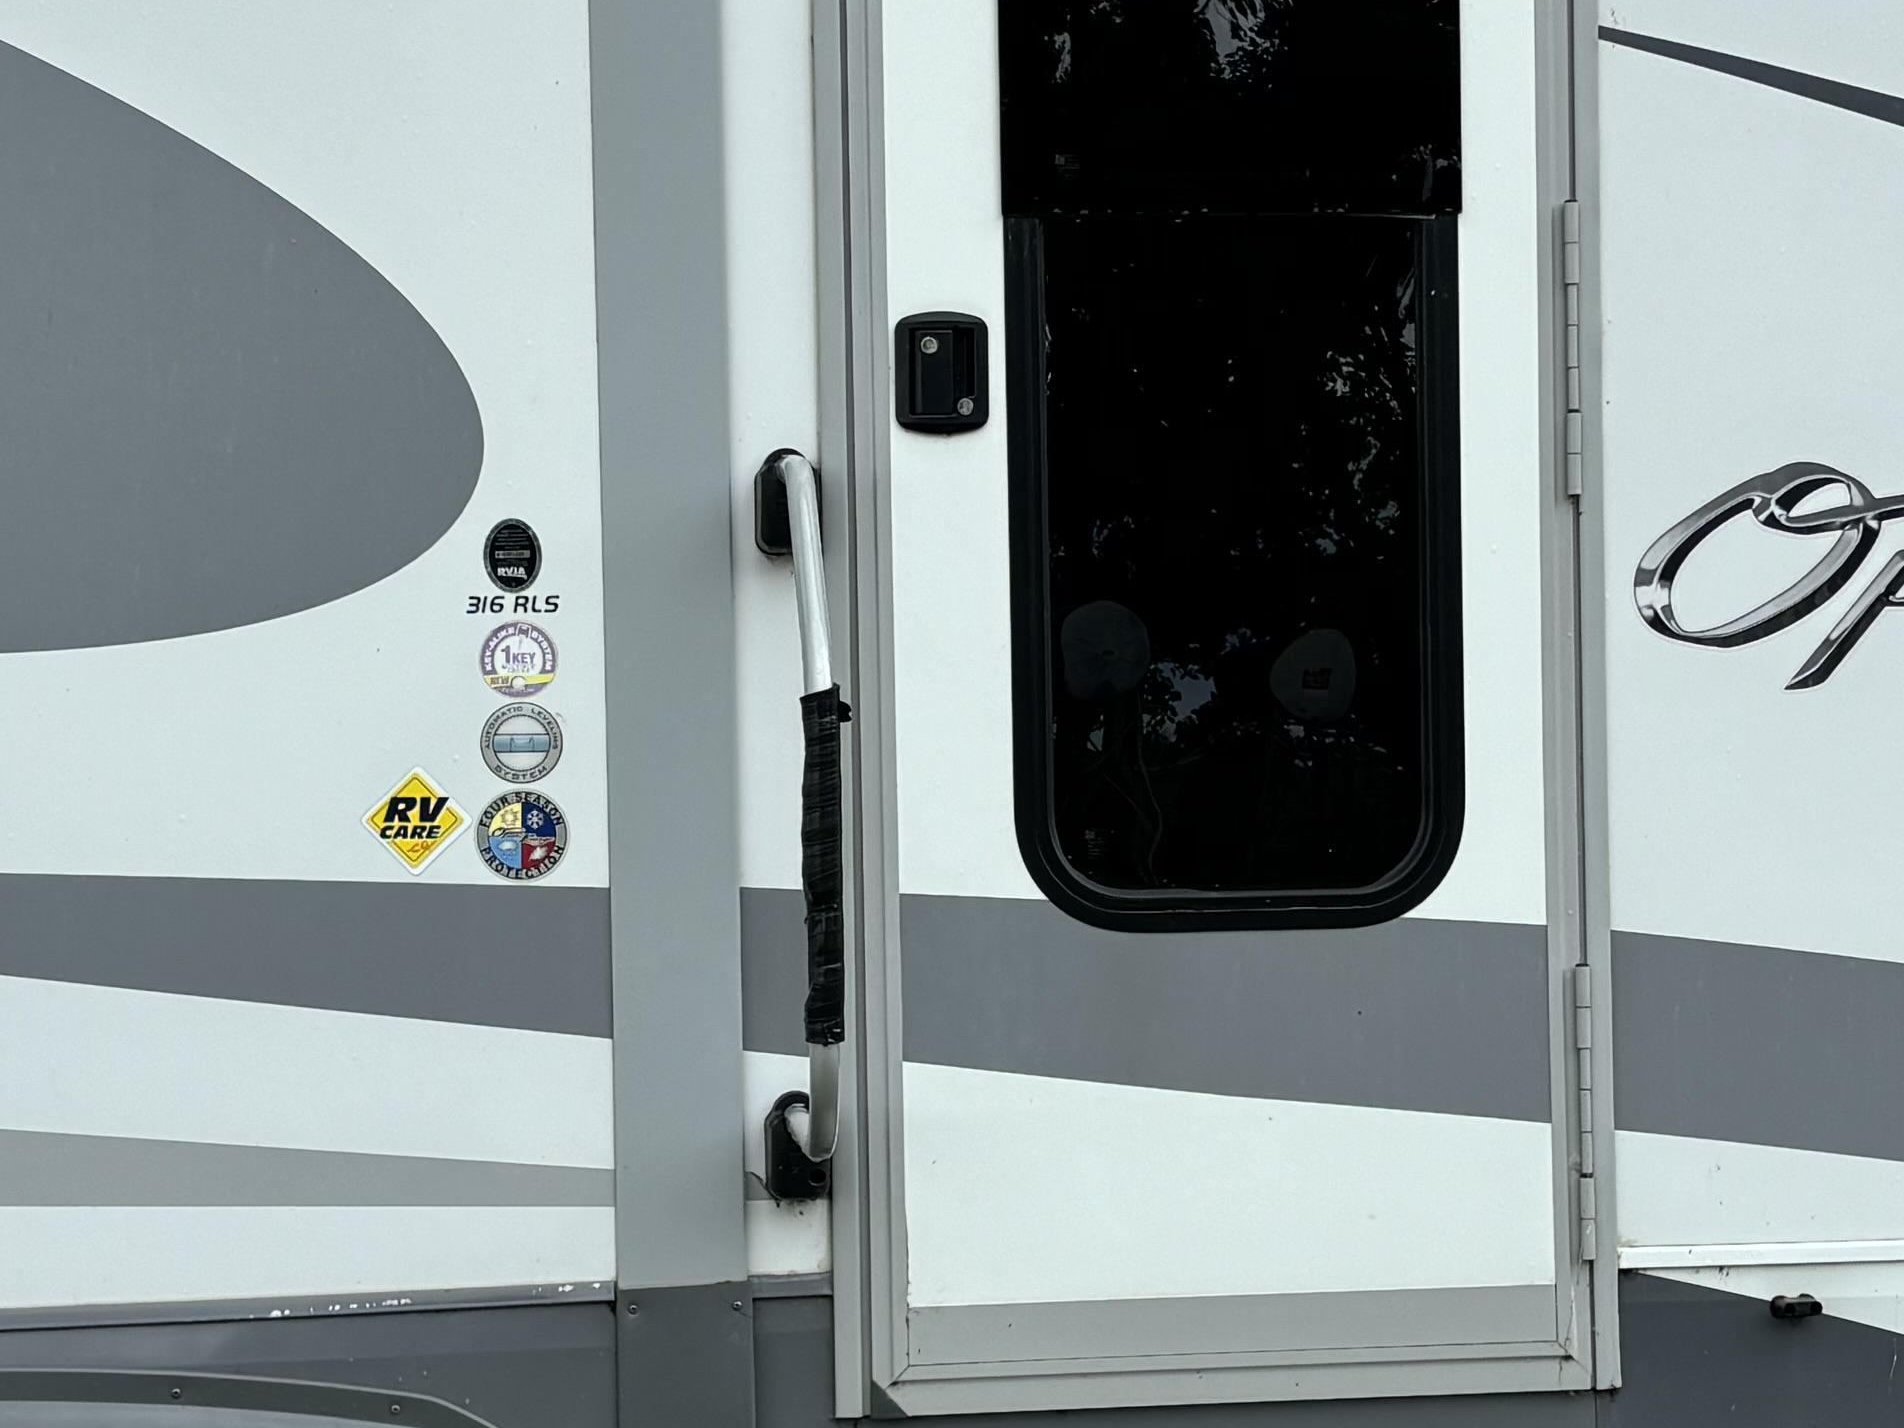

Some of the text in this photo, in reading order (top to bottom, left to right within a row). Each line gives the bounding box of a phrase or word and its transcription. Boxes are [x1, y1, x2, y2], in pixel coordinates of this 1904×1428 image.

[466, 595, 560, 614] 316 RLS
[484, 706, 523, 749] AUTOMATIC
[383, 796, 450, 823] RV
[479, 792, 564, 827] FOUR SEASON
[379, 824, 442, 840] CARE
[481, 845, 564, 879] PROTECTION
